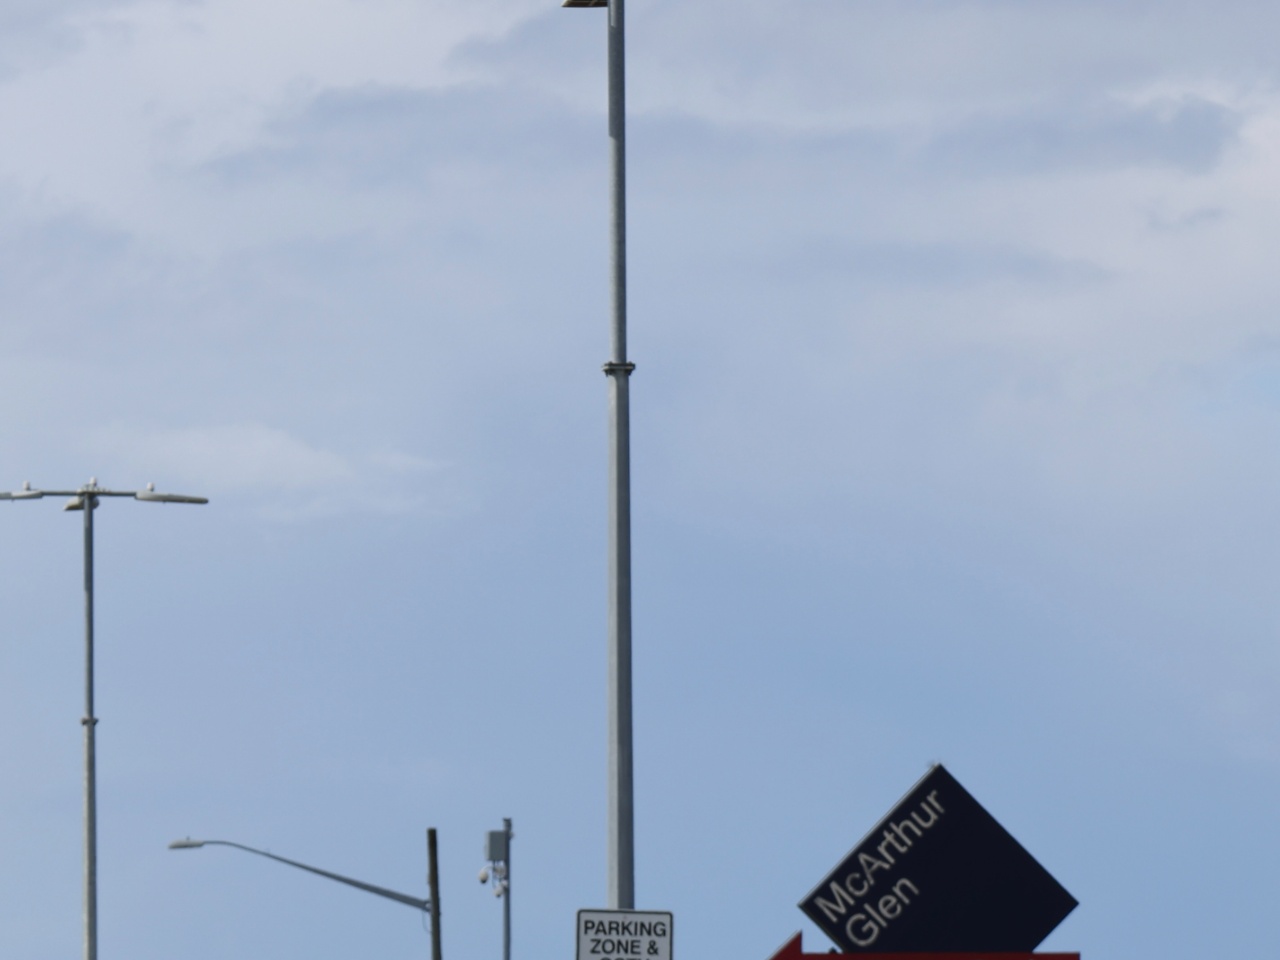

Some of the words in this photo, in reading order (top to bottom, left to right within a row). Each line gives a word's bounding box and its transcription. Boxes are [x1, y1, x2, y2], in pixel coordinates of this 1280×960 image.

[813, 789, 945, 923] McArthur
[583, 919, 667, 937] PARKING
[845, 877, 919, 947] Glen
[589, 938, 642, 955] ZONE
[647, 940, 659, 955] &
